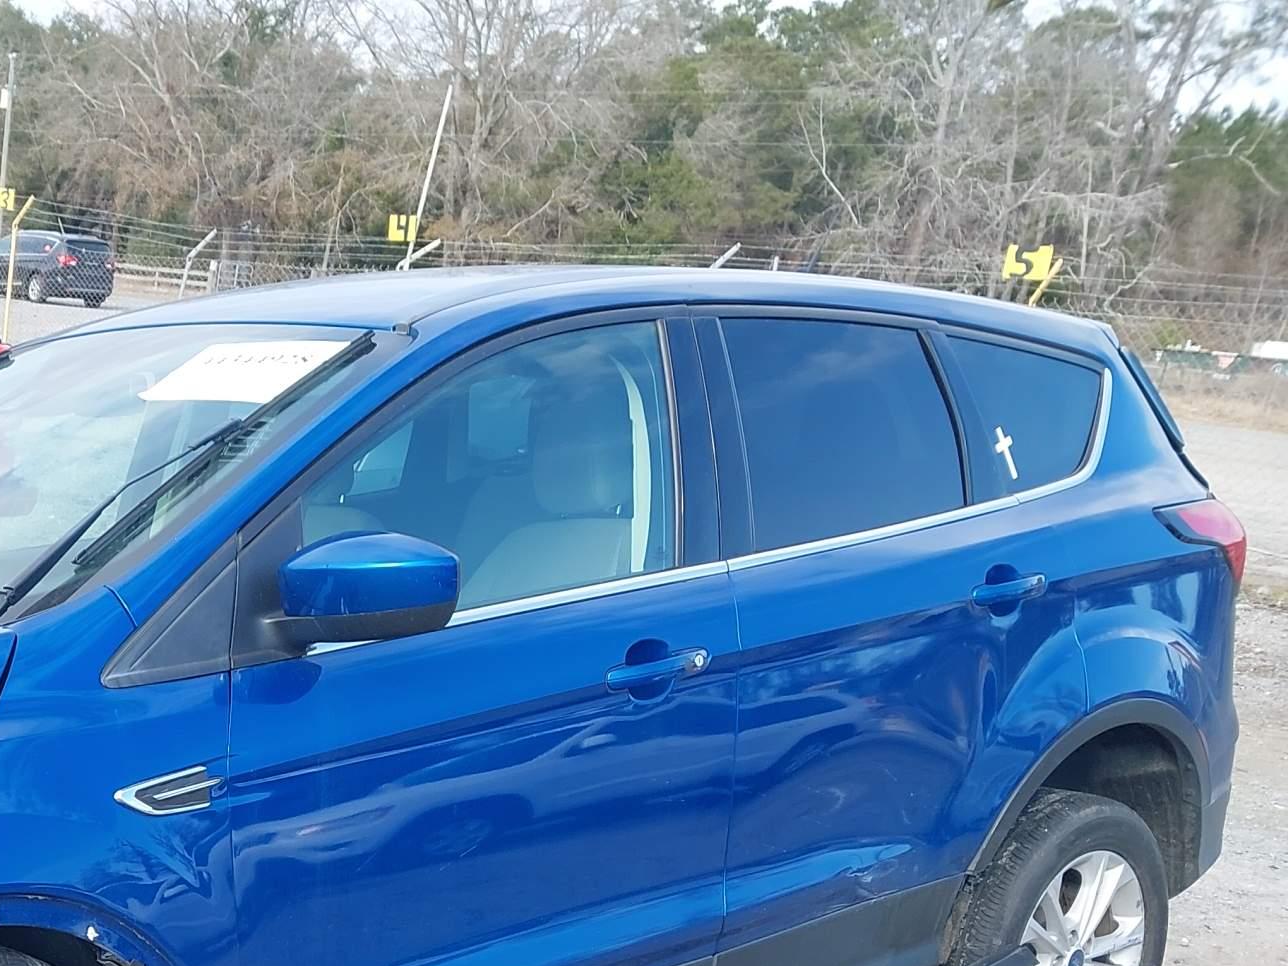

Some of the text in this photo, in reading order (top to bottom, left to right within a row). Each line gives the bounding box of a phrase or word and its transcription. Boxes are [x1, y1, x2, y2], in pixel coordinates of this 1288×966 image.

[0, 188, 10, 209] 3
[396, 213, 410, 242] 4
[1009, 244, 1039, 278] 5
